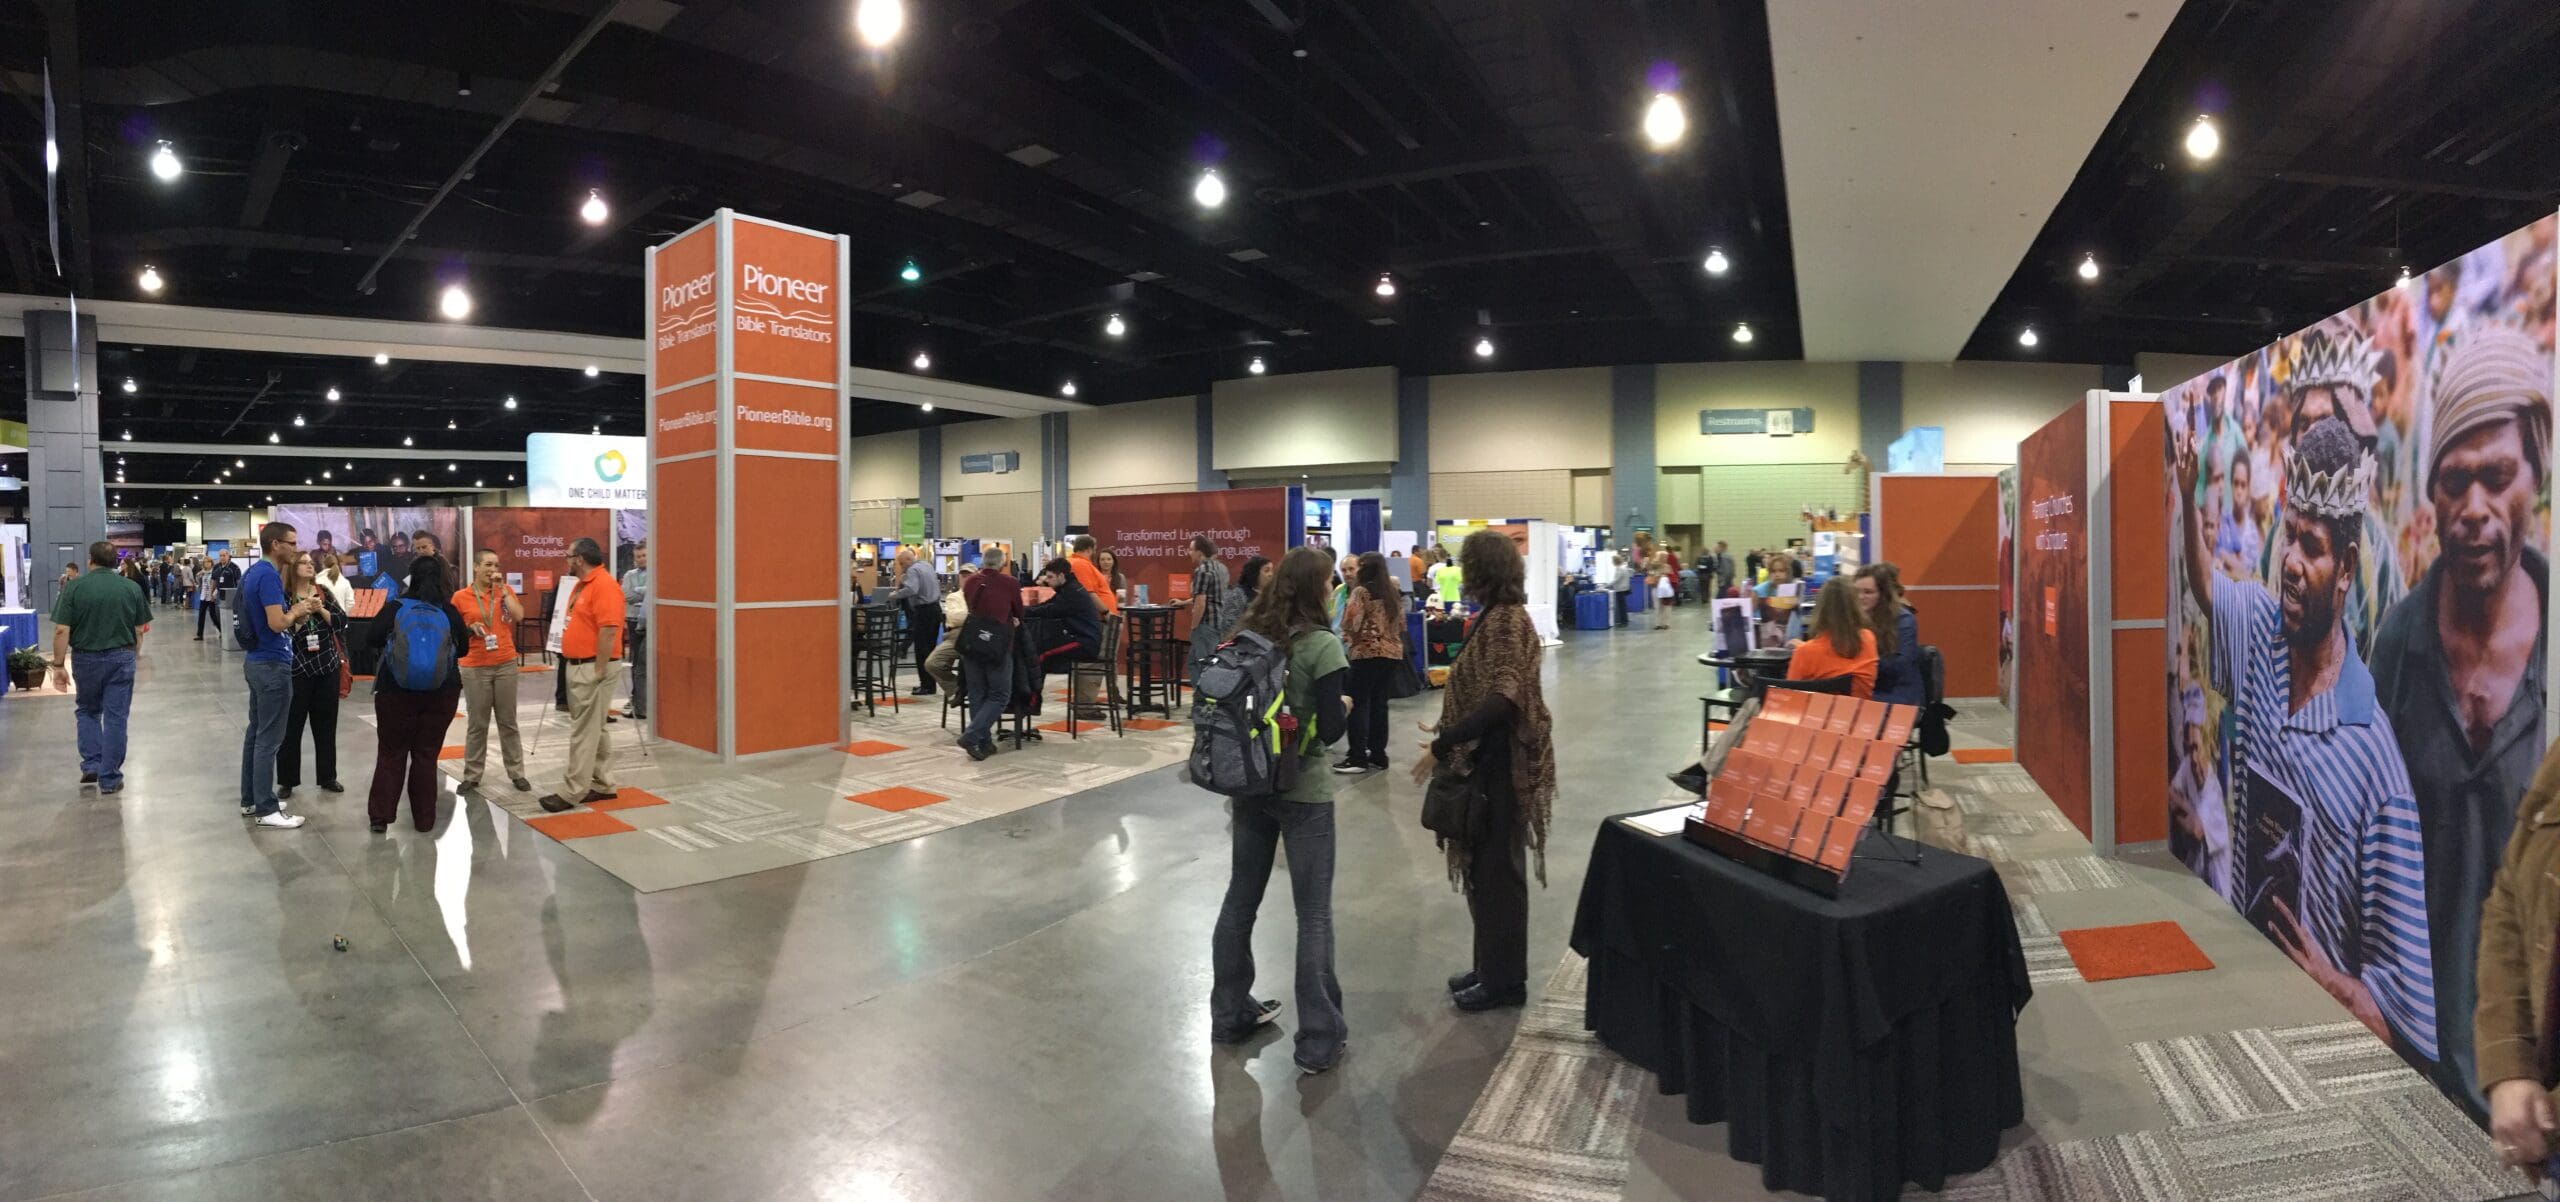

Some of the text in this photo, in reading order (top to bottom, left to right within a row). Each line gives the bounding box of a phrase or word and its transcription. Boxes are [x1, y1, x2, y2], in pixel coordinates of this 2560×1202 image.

[663, 272, 716, 312] Pioneer
[743, 264, 828, 303] Pioneer
[736, 316, 832, 344] Bible Translators
[659, 333, 675, 351] Bible
[737, 405, 832, 431] PioneerBible.org
[568, 487, 585, 498] ONE
[587, 488, 610, 498] CHILD
[522, 535, 564, 546] Discipling
[1116, 529, 1177, 541] Transformed
[1207, 526, 1251, 542] through
[515, 549, 531, 558] the
[1108, 545, 1134, 557] od's
[1136, 546, 1163, 557] Word
[1165, 547, 1175, 557] in
